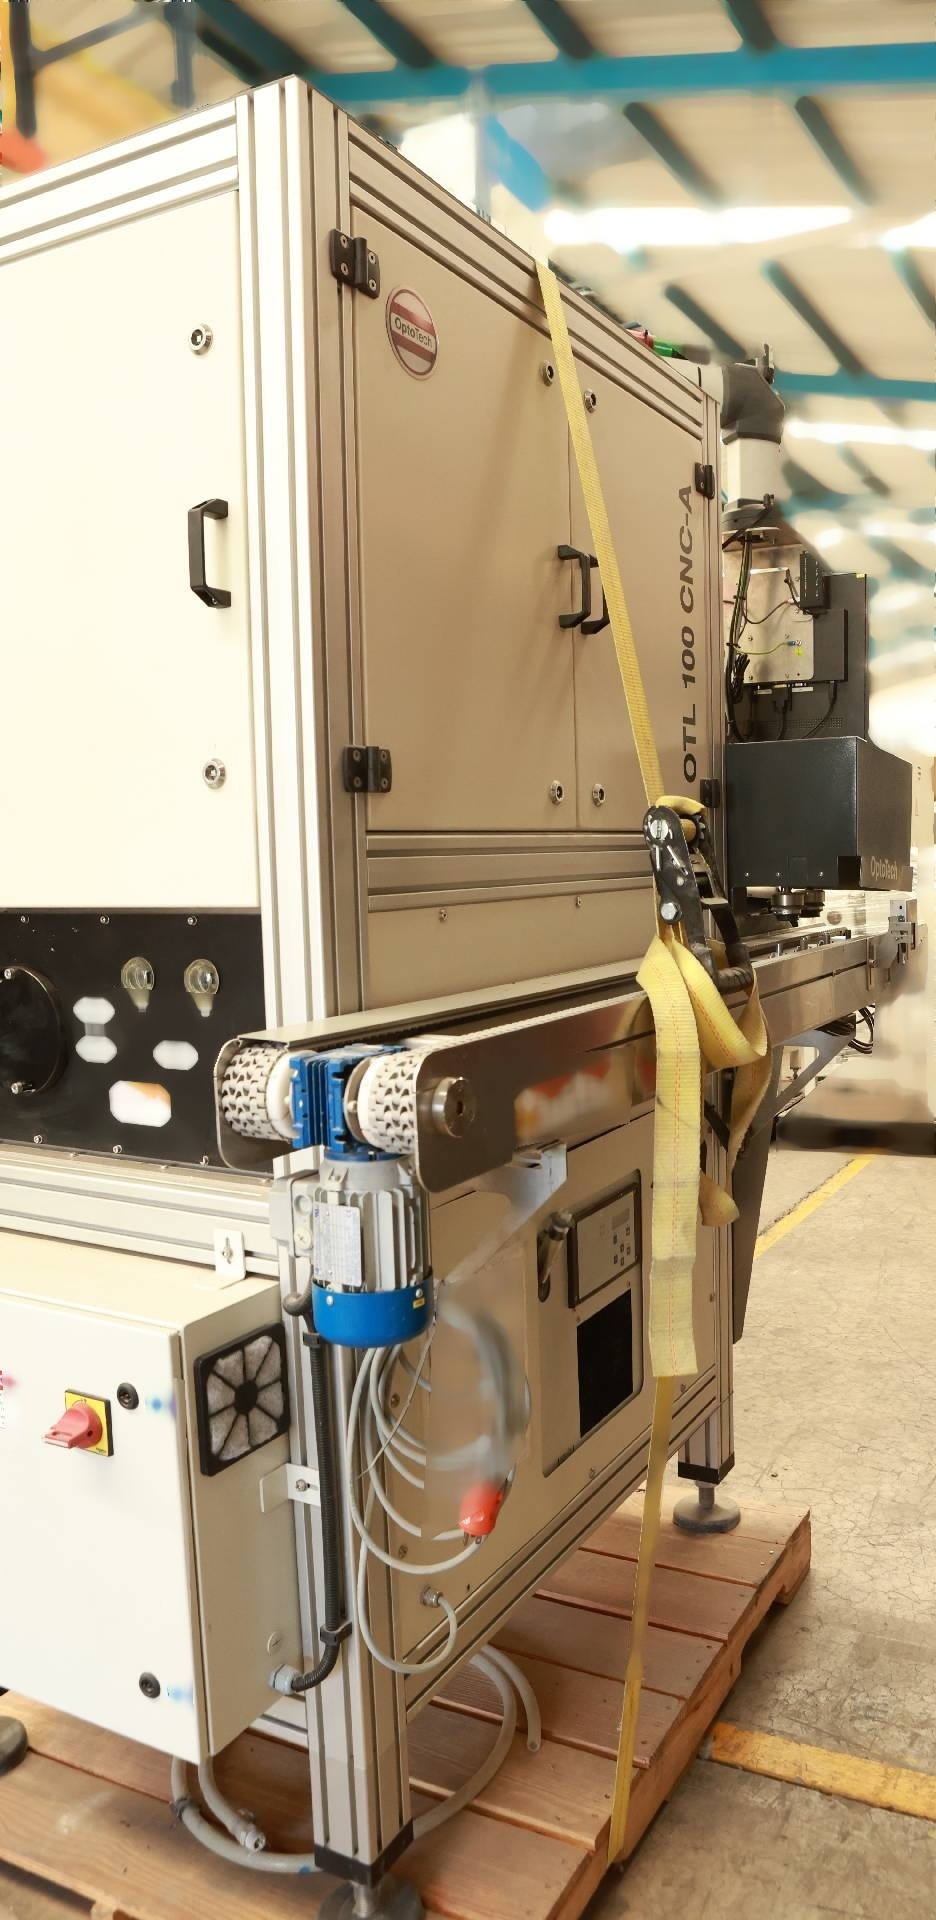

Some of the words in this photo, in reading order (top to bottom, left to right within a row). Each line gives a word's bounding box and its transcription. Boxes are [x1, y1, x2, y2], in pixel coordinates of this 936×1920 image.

[394, 316, 433, 349] OptoTech
[678, 485, 694, 614] CNC-A
[681, 626, 696, 688] 100
[682, 703, 697, 783] OTL
[870, 856, 898, 881] OptoTech
